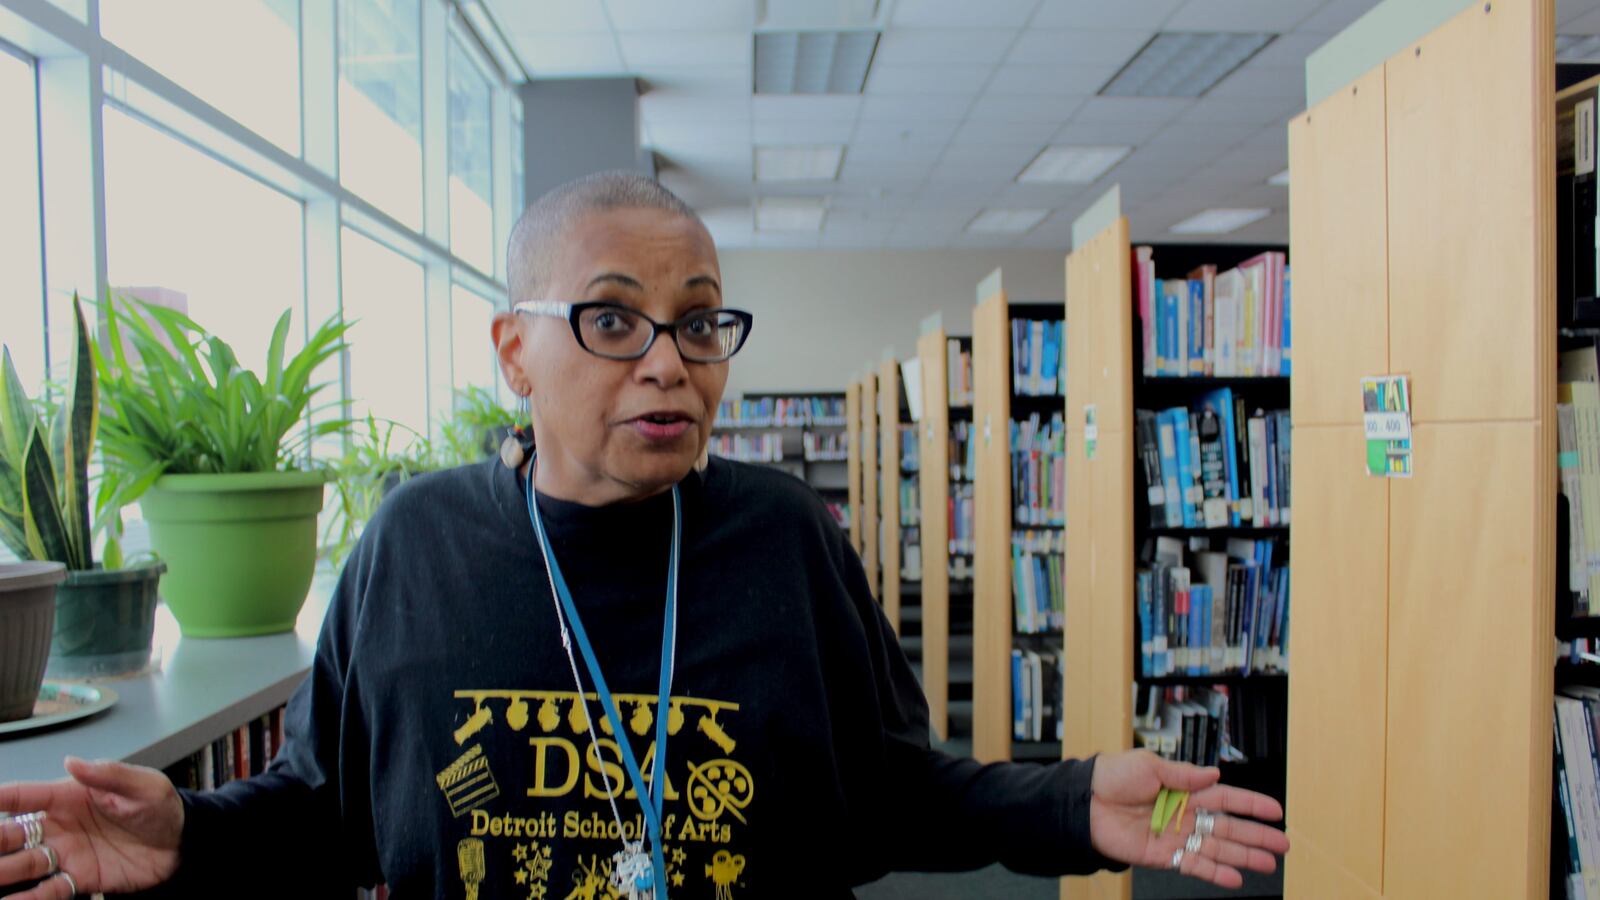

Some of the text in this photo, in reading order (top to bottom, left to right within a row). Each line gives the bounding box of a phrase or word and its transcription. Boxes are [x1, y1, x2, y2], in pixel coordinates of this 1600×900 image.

[526, 736, 680, 801] DSA
[470, 809, 557, 838] Detroit
[563, 811, 642, 840] School
[678, 814, 731, 844] Arts
